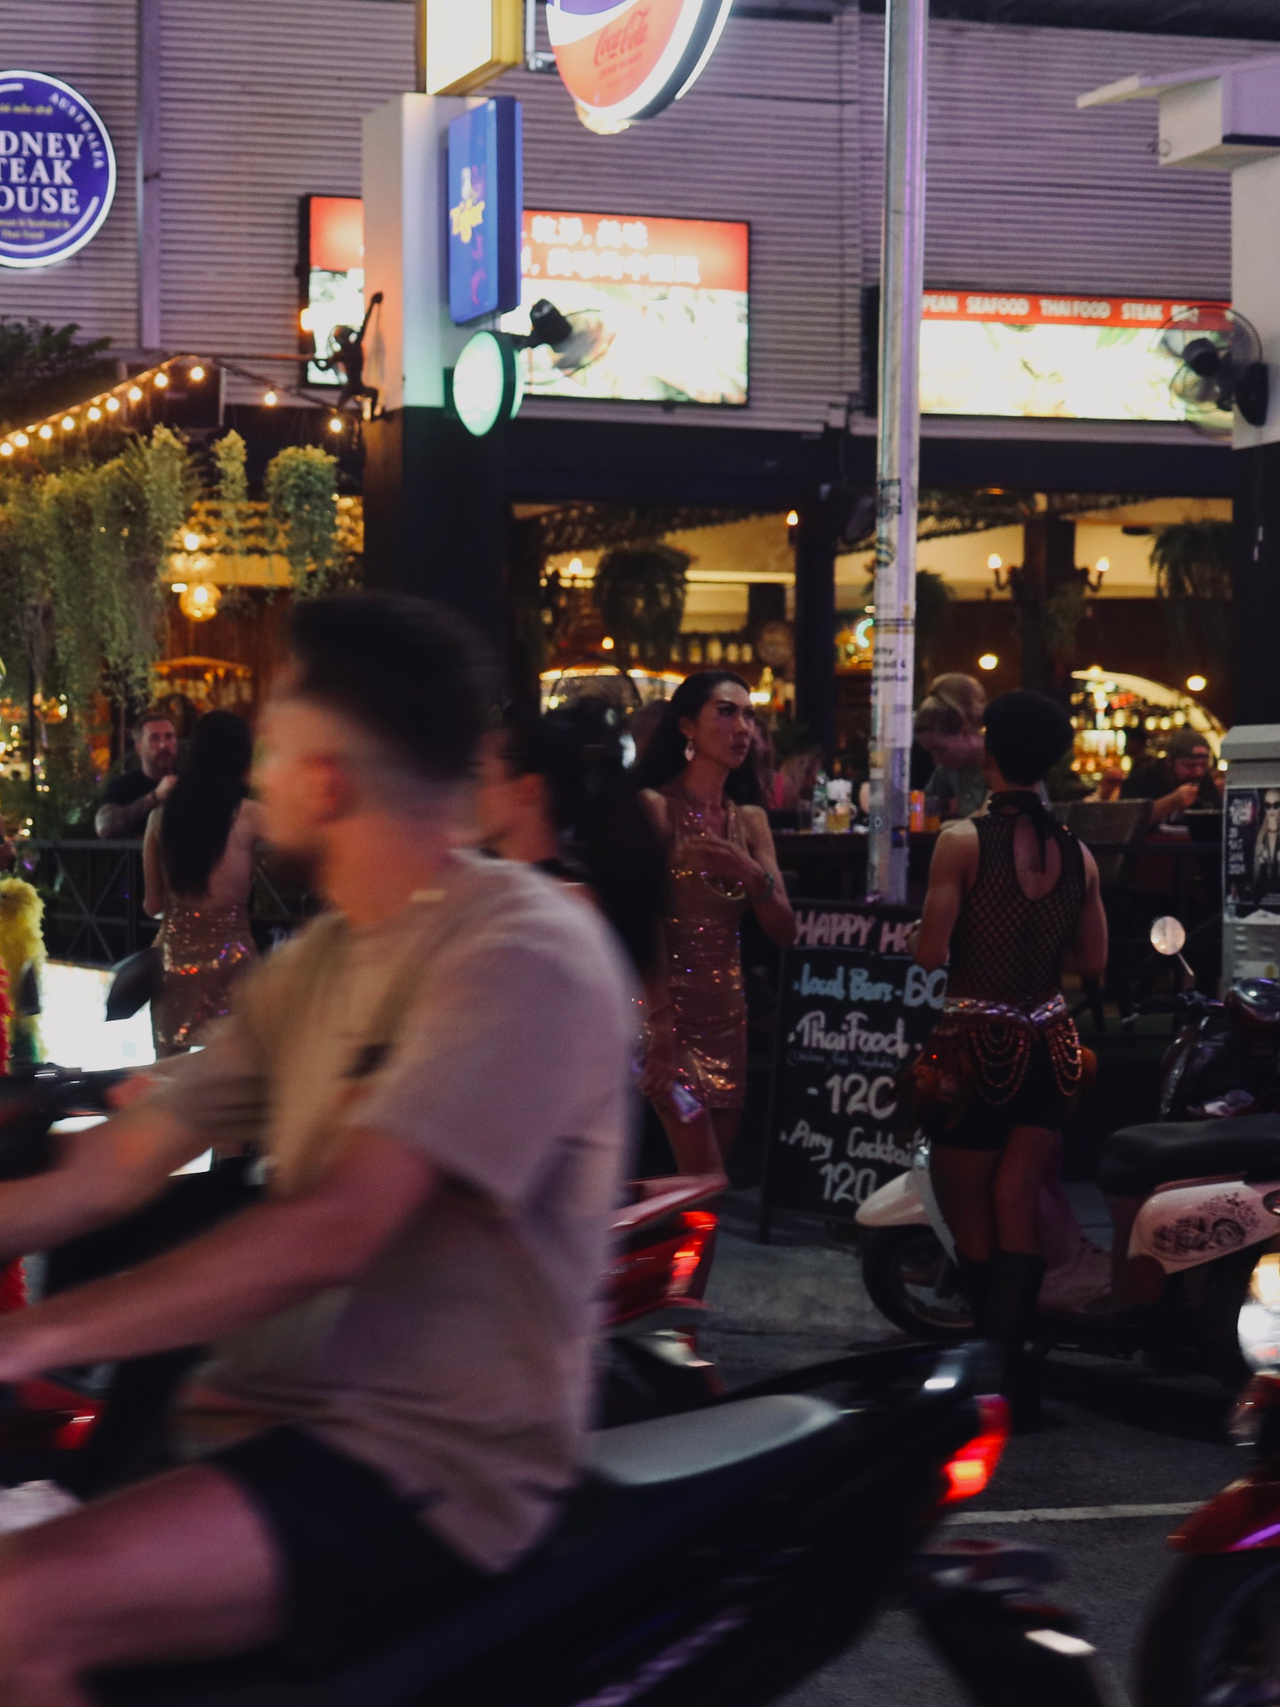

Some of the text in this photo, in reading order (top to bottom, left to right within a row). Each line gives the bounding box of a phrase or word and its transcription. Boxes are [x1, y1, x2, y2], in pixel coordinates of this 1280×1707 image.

[966, 296, 1030, 317] SEAFOOD
[1072, 300, 1111, 319] FOOD
[1121, 302, 1163, 321] STEAK
[794, 911, 875, 946] HAPPY
